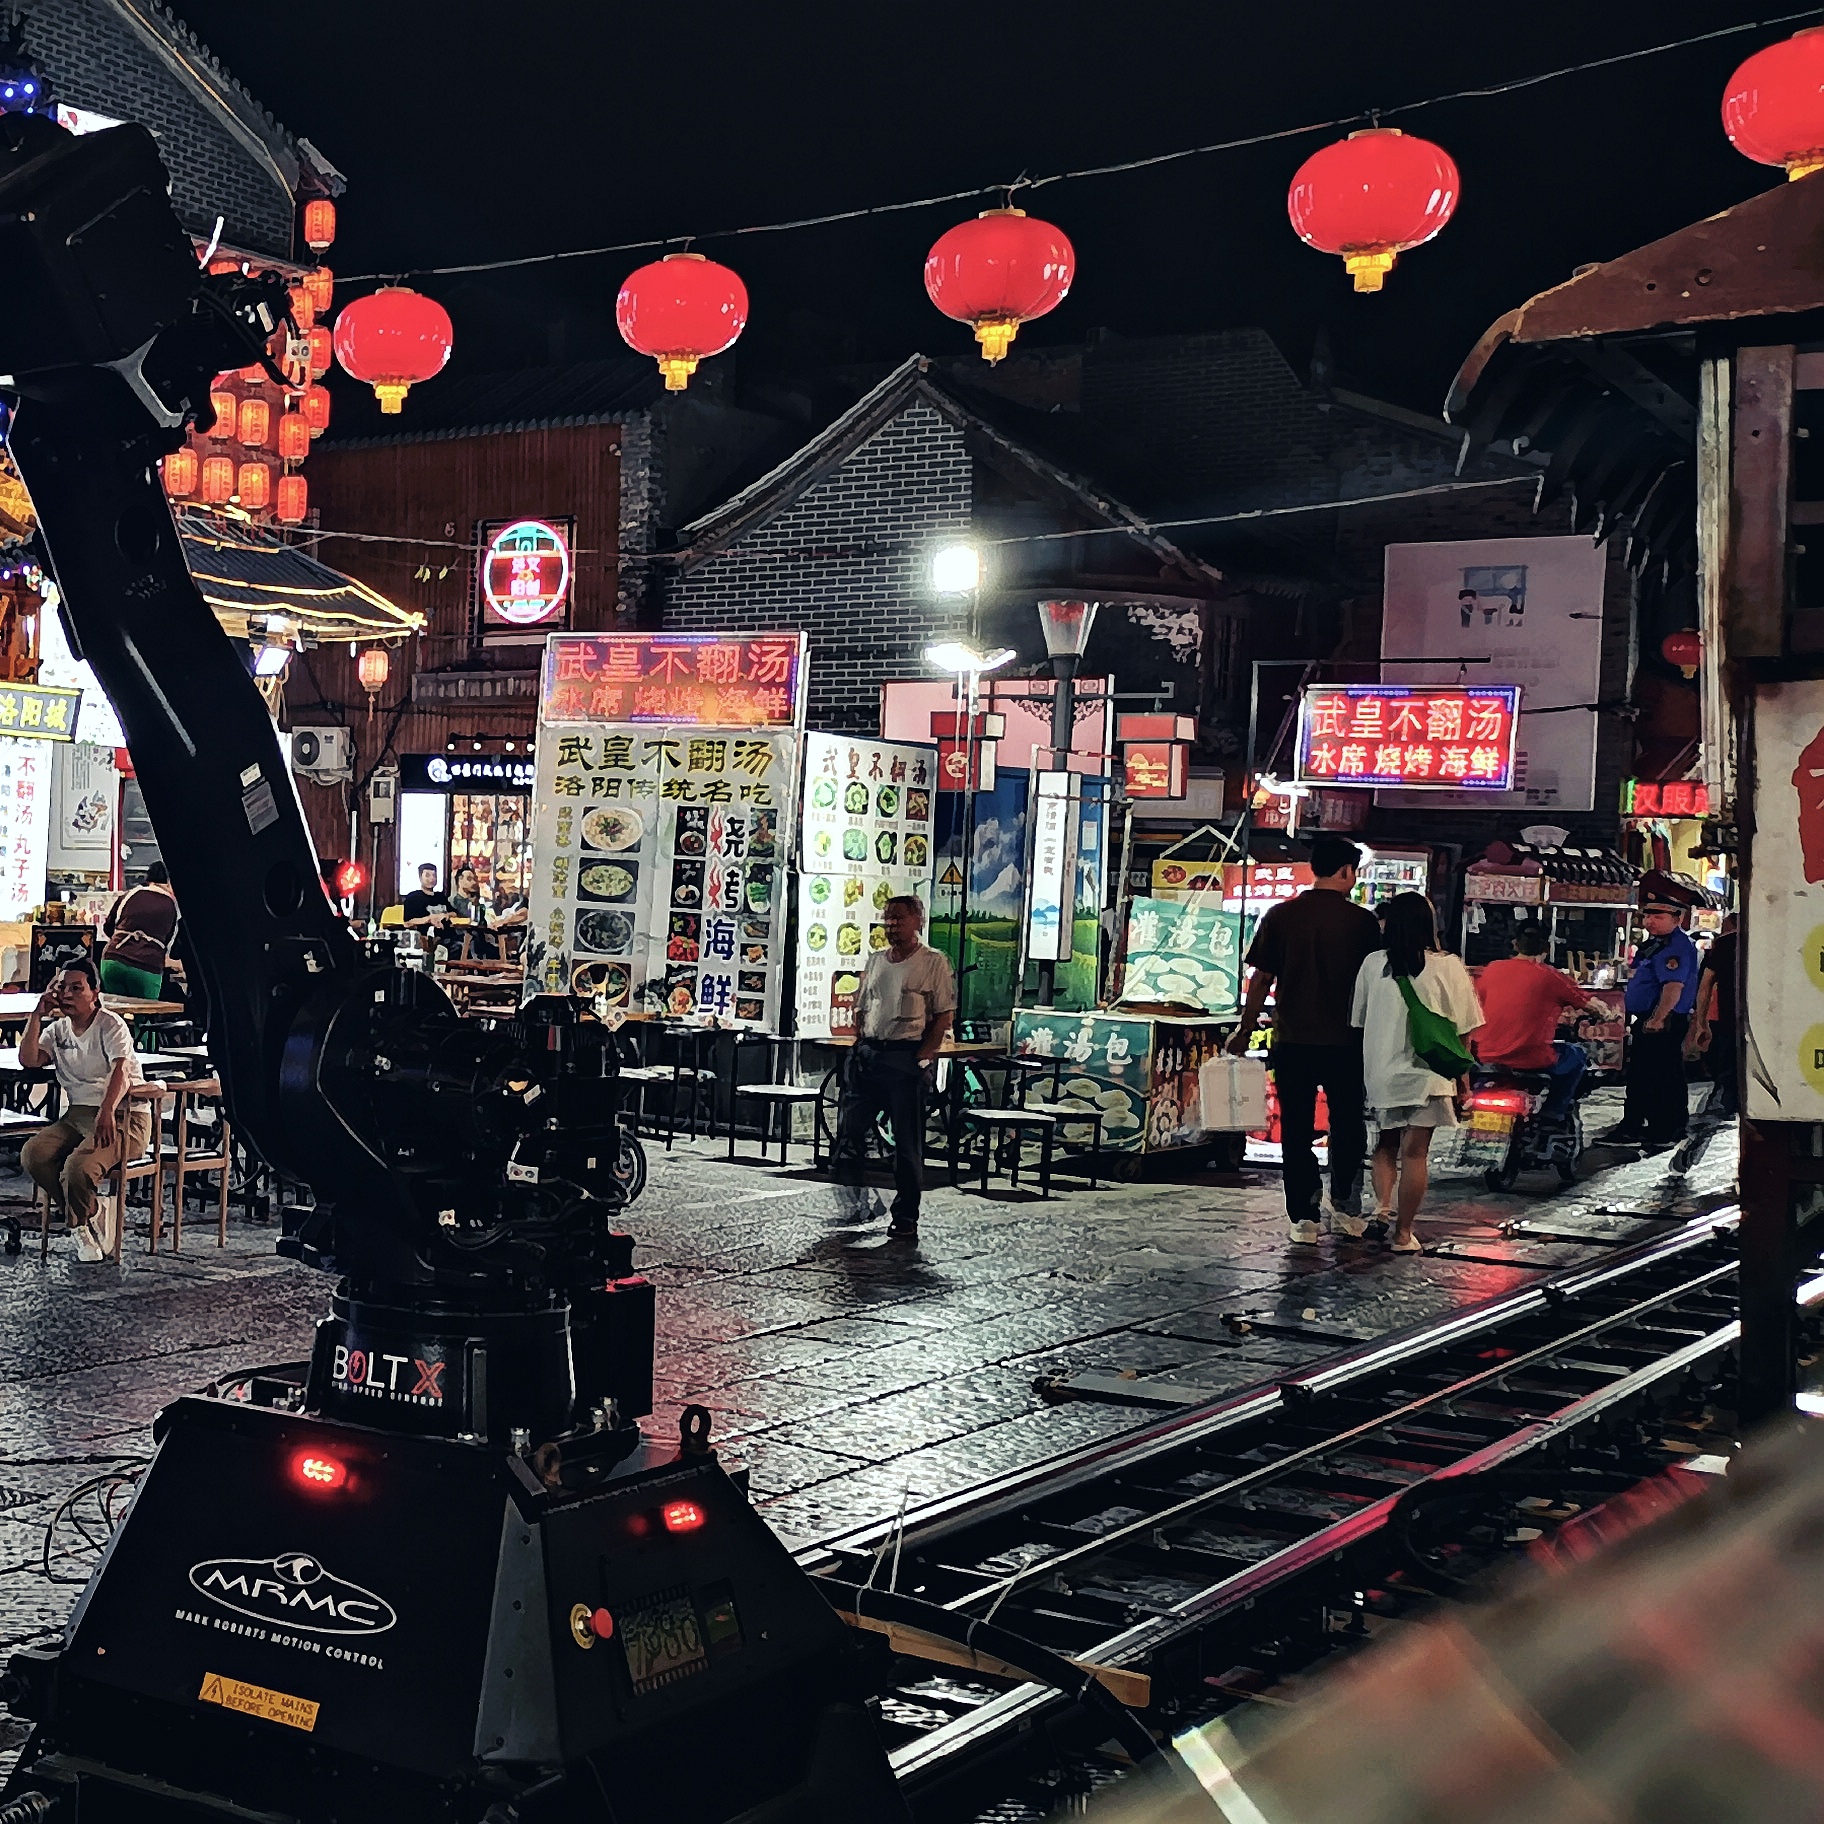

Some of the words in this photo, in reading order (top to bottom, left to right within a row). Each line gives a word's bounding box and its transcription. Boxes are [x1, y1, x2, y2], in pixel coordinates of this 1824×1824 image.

[555, 641, 792, 684] 武皇不翻汤
[555, 685, 623, 717] 水席
[717, 686, 788, 718] 海鲜
[1311, 695, 1503, 742] 武皇不翻汤
[558, 735, 774, 778] 武皇不翻汤
[823, 745, 927, 785] 武皇不翻汤
[1311, 742, 1367, 775] 水席
[1372, 744, 1433, 777] 烧烤
[1438, 745, 1499, 779] 海鲜
[15, 756, 36, 825] 不翻汤
[554, 775, 773, 805] 洛阳传统名吃
[11, 834, 32, 903] 丸子汤
[698, 806, 746, 1015] 烧烤海鲜
[333, 1345, 409, 1391] BOLT
[411, 1359, 446, 1398] X
[203, 1569, 380, 1626] MRMC
[175, 1609, 209, 1626] MARK
[213, 1618, 266, 1640] ROBERTS
[270, 1632, 321, 1654] MOTION
[325, 1646, 384, 1670] CONTROL
[225, 1696, 264, 1715] BEFORE
[267, 1708, 314, 1728] OPENING
[232, 1683, 277, 1705] ISOLATE
[280, 1697, 314, 1715] MAINS
